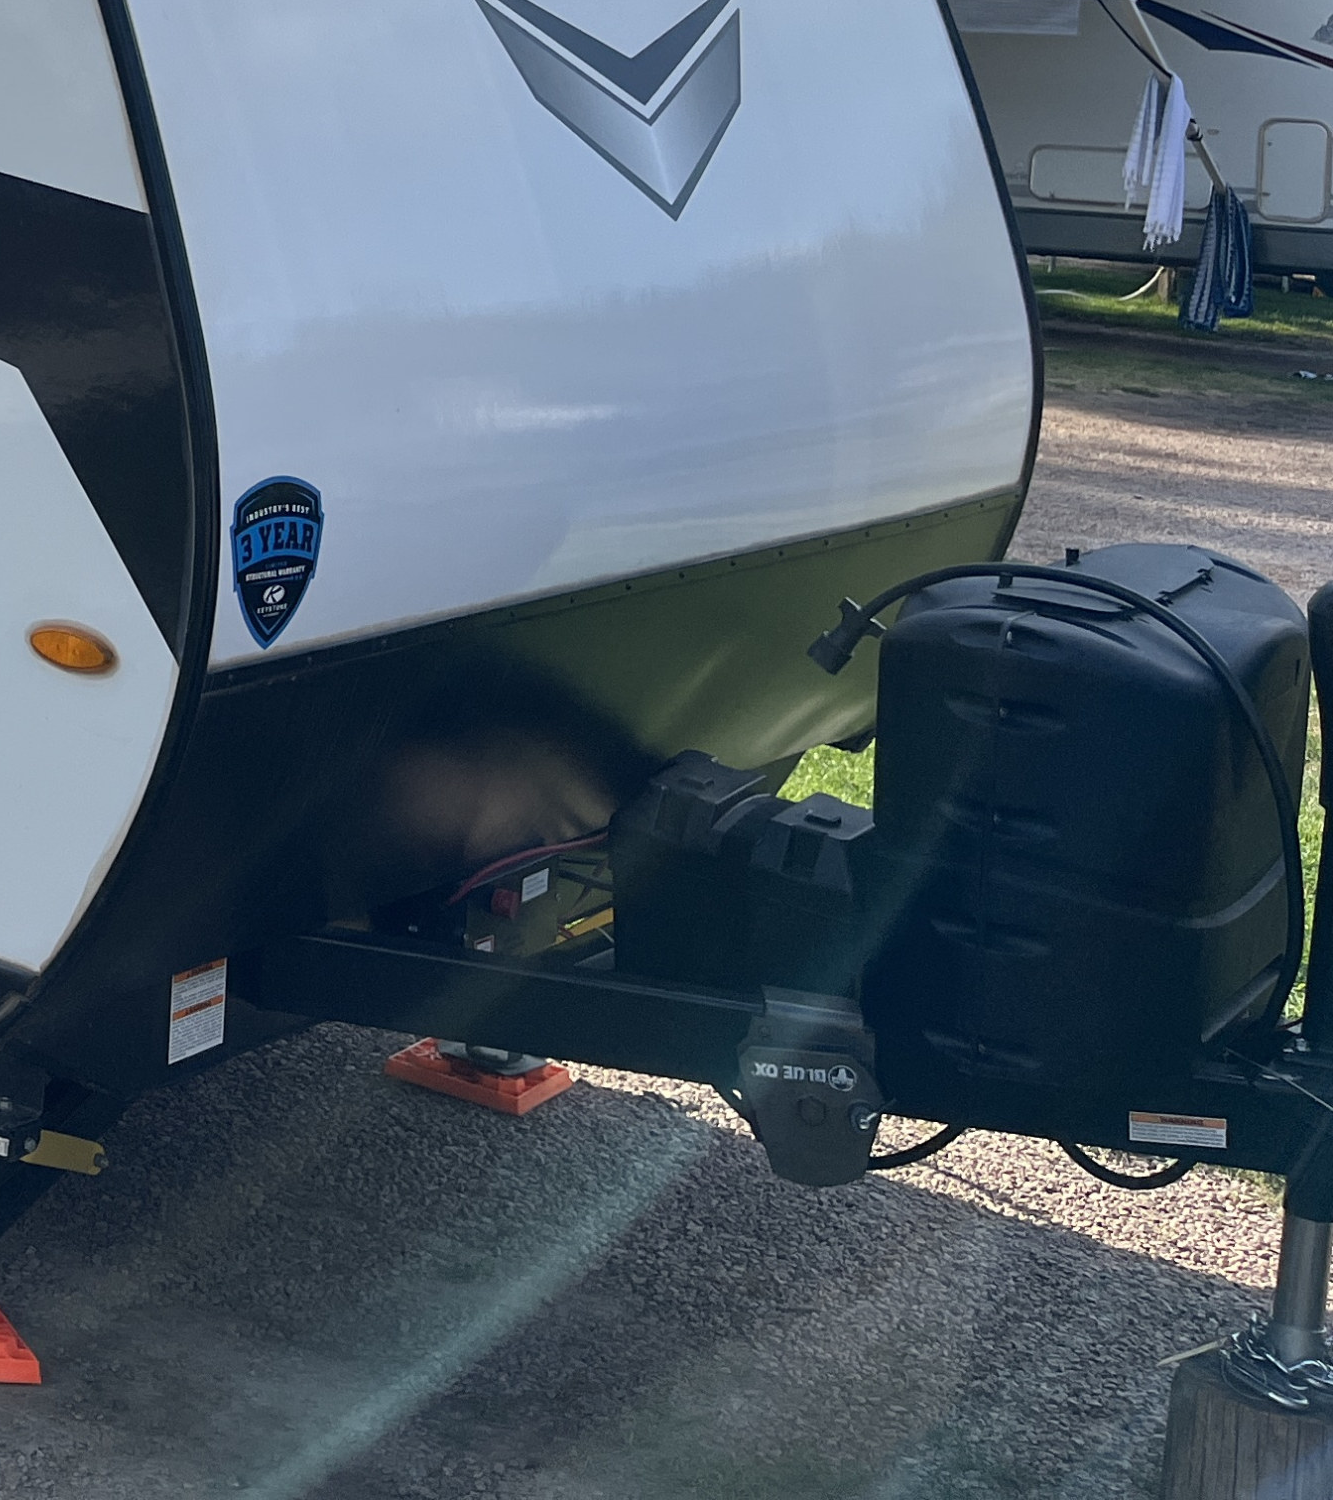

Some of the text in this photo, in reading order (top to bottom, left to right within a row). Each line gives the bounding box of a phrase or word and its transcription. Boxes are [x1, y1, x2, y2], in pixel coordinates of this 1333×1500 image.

[292, 504, 310, 514] BEST
[240, 521, 314, 564] 3 YEAR
[782, 1064, 826, 1083] BLUE
